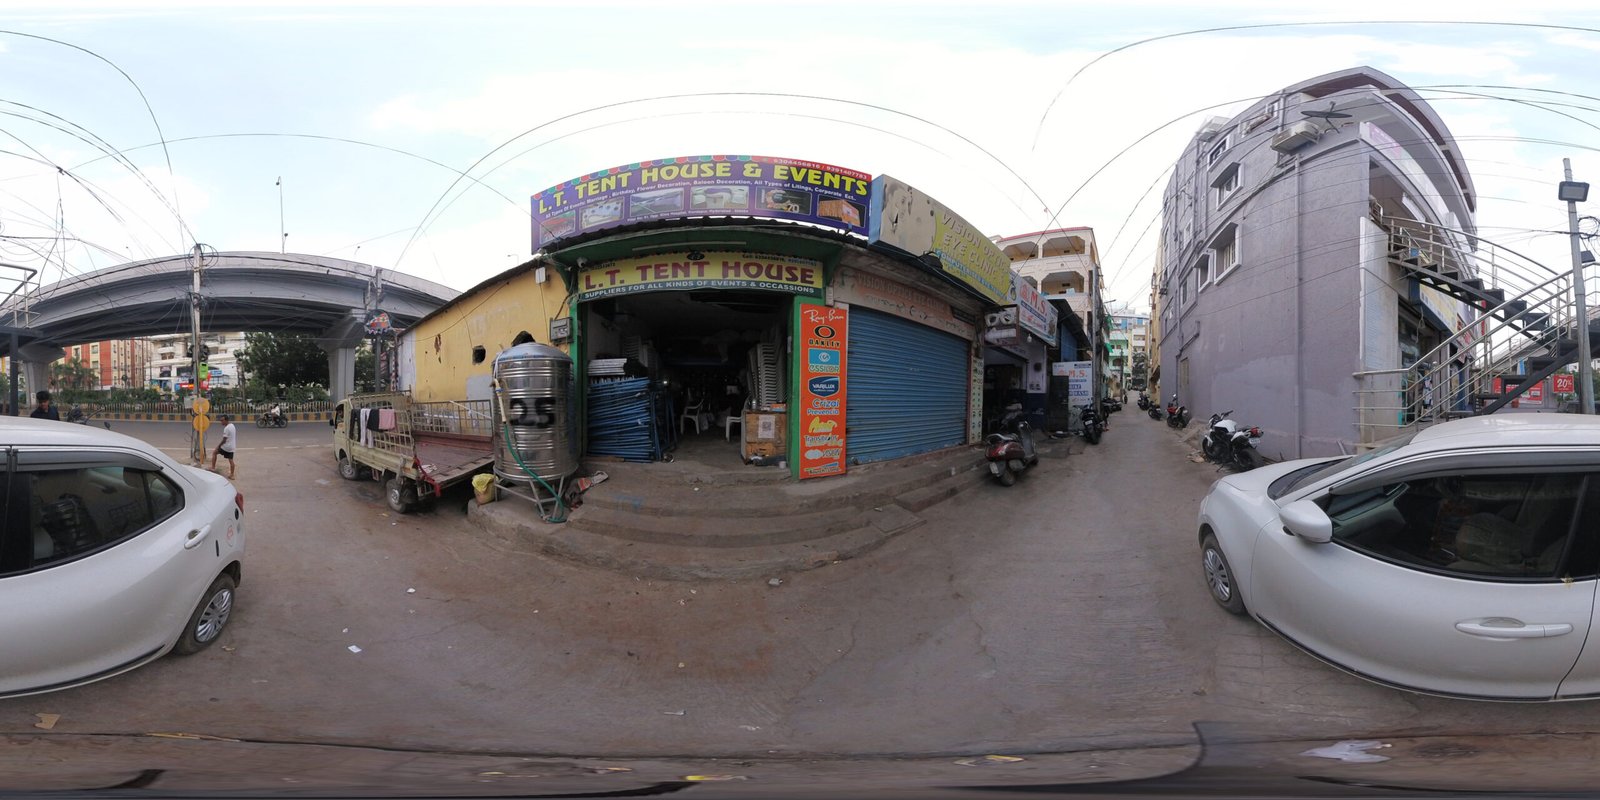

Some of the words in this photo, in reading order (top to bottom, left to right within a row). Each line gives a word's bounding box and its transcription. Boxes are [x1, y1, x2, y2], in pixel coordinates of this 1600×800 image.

[575, 172, 632, 200] TENT
[641, 162, 732, 186] HOUSE
[742, 163, 763, 178] &
[773, 164, 868, 196] EVENTS
[657, 181, 692, 189] Decoration,
[814, 187, 842, 197] Corporate
[943, 213, 982, 249] VISION
[636, 261, 710, 281] TENT
[722, 261, 814, 285] HOUSE
[584, 287, 626, 299] SUPPLIERS
[759, 281, 815, 294] OCCASSIONS
[808, 338, 841, 348] OAKLEY
